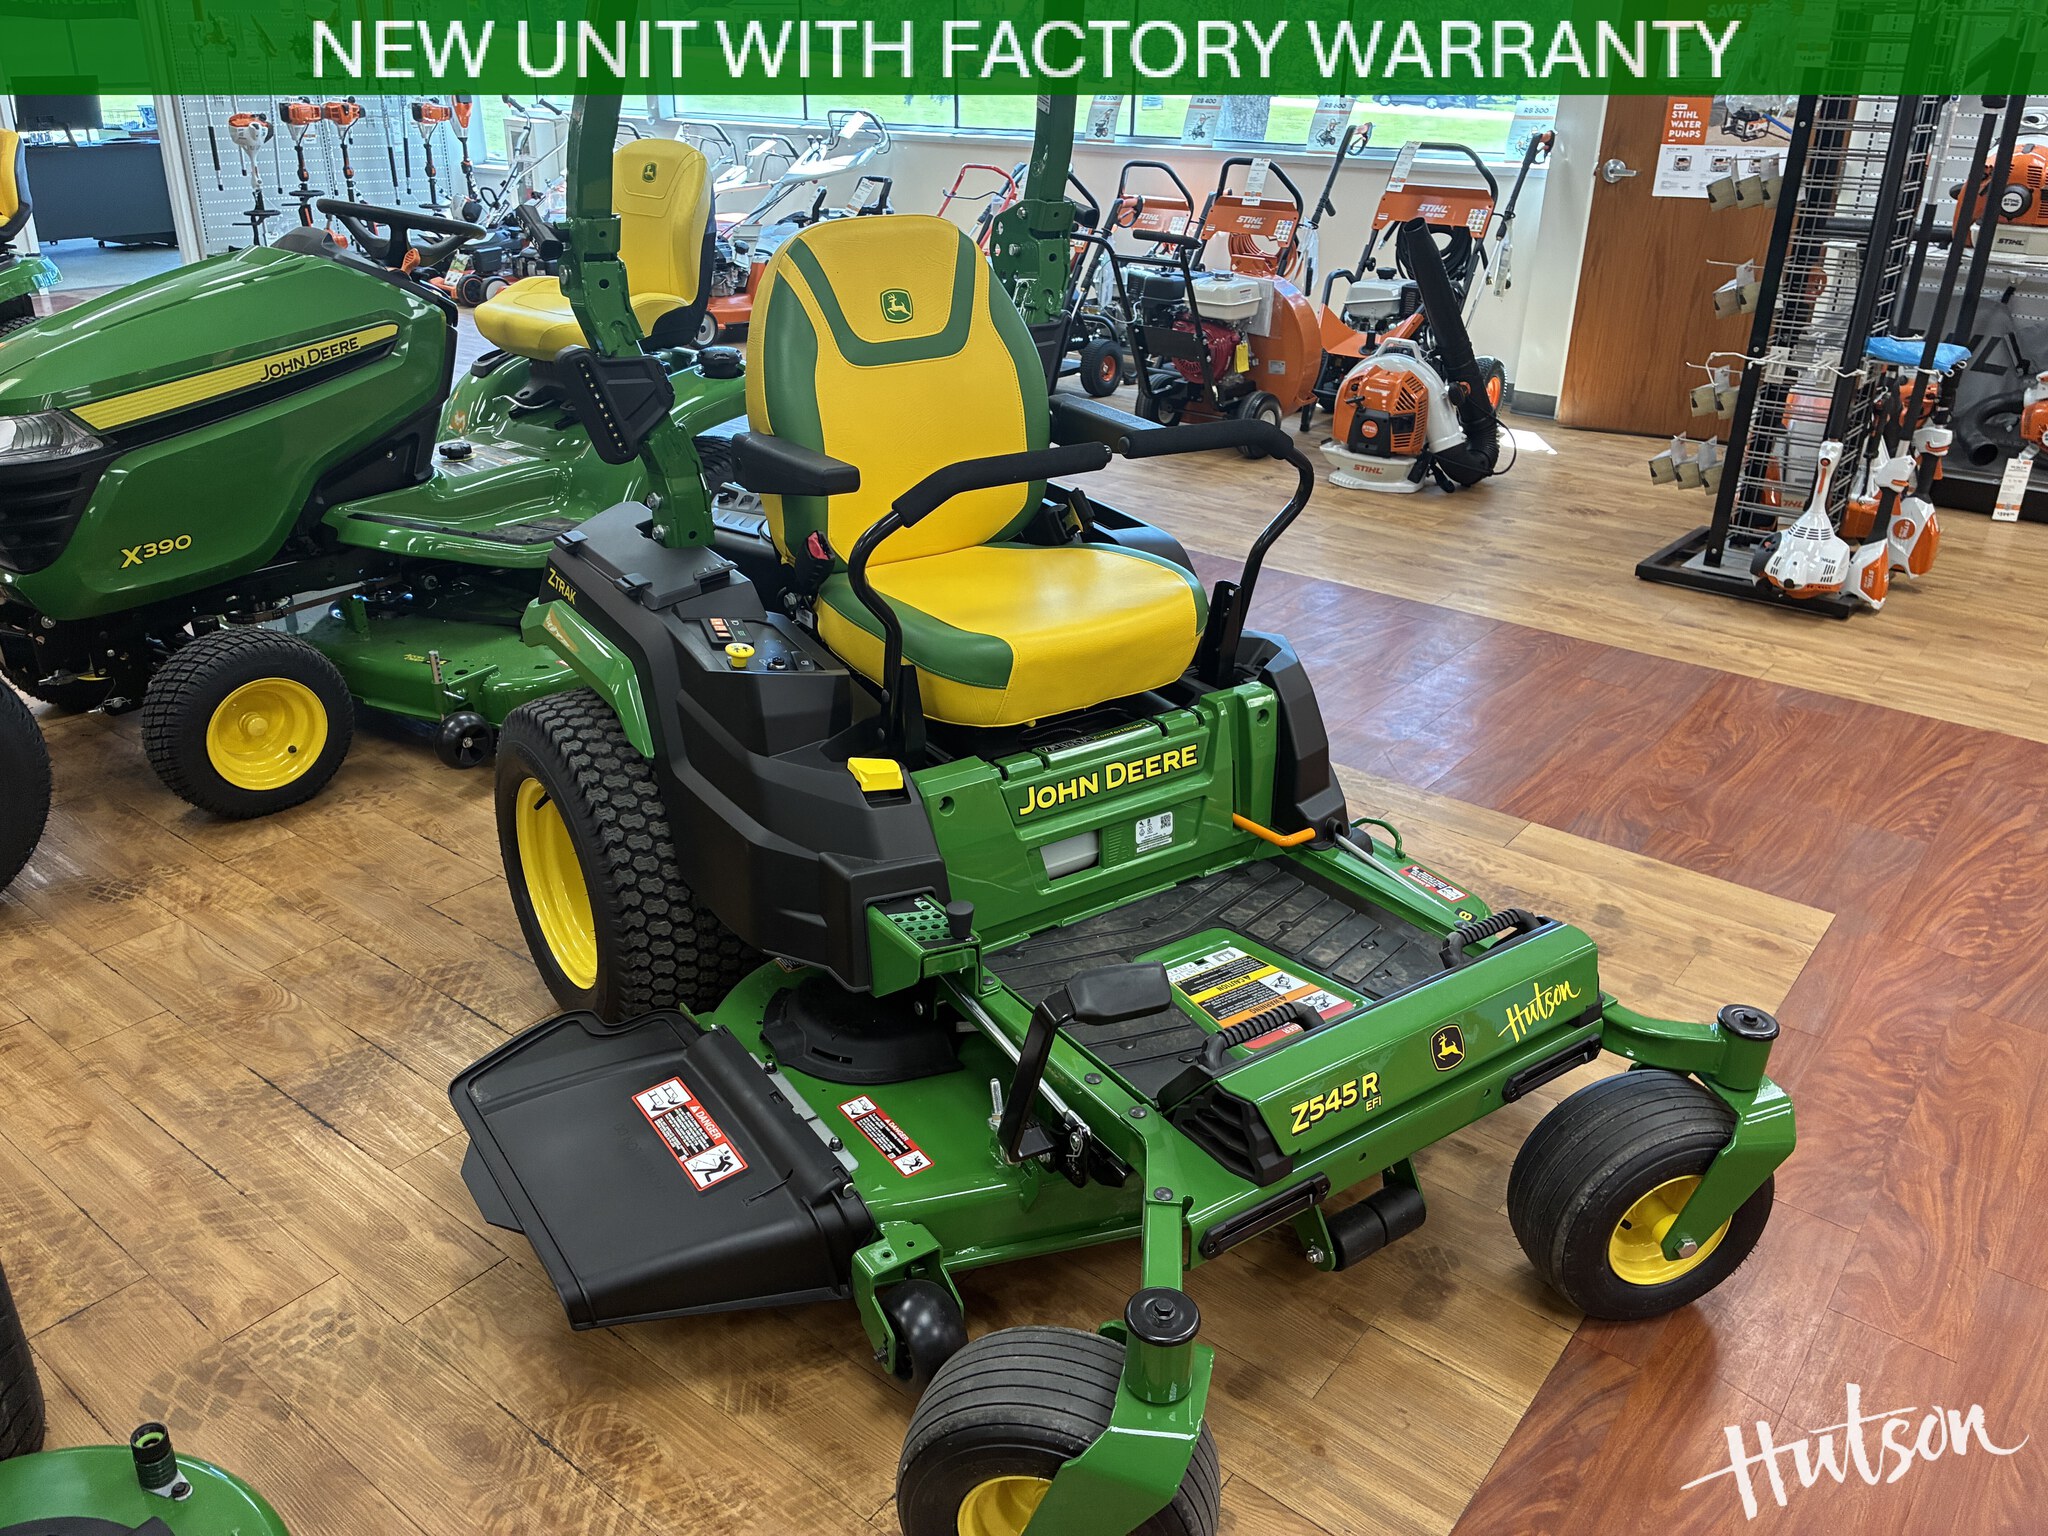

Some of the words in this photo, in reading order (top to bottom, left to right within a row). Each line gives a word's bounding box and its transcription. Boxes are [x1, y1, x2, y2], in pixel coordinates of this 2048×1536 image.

[1671, 111, 1698, 119] STIHL
[1670, 120, 1702, 129] WATER
[1668, 130, 1701, 139] PUMPS
[1417, 203, 1448, 213] STIHL
[1236, 215, 1264, 224] STIHL
[1997, 238, 2024, 246] STIHL
[260, 353, 307, 384] JOHN
[308, 335, 361, 367] DEERE
[1353, 464, 1383, 475] STIHL
[120, 534, 193, 569] X390
[547, 568, 577, 605] ZTRAK
[1018, 771, 1100, 816] JOHN
[1105, 743, 1199, 789] DEERE
[1216, 976, 1245, 992] CAUTION
[1249, 998, 1281, 1014] WARNING
[1498, 980, 1581, 1042] Hutson
[1364, 1095, 1383, 1112] EFI
[694, 1110, 722, 1140] DANGER
[887, 1121, 910, 1141] DANGER
